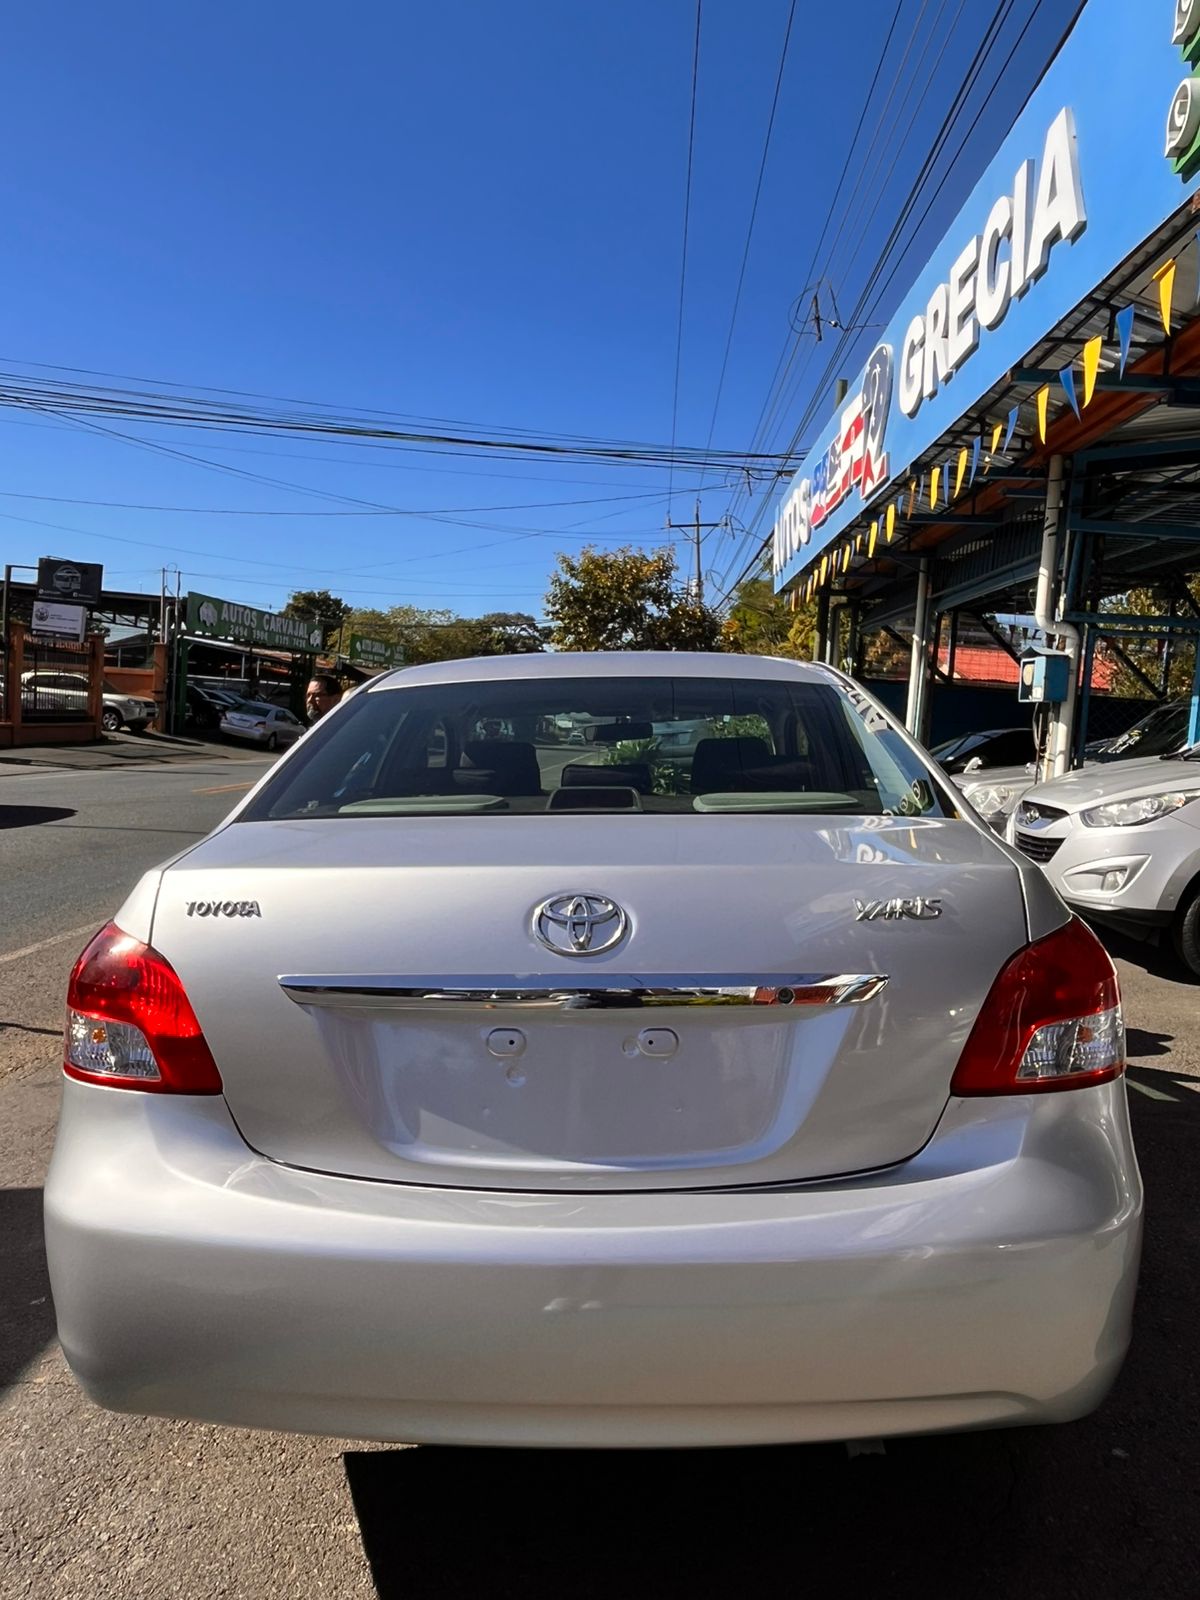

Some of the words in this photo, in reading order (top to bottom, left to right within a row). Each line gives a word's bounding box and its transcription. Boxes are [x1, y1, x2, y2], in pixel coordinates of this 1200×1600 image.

[773, 479, 812, 576] AUTOS
[899, 106, 1087, 418] GRECIA
[221, 602, 258, 629] AUTOS
[263, 613, 309, 639] CARVAJAL
[185, 900, 262, 918] TOYOTA
[852, 896, 943, 921] YARIS
